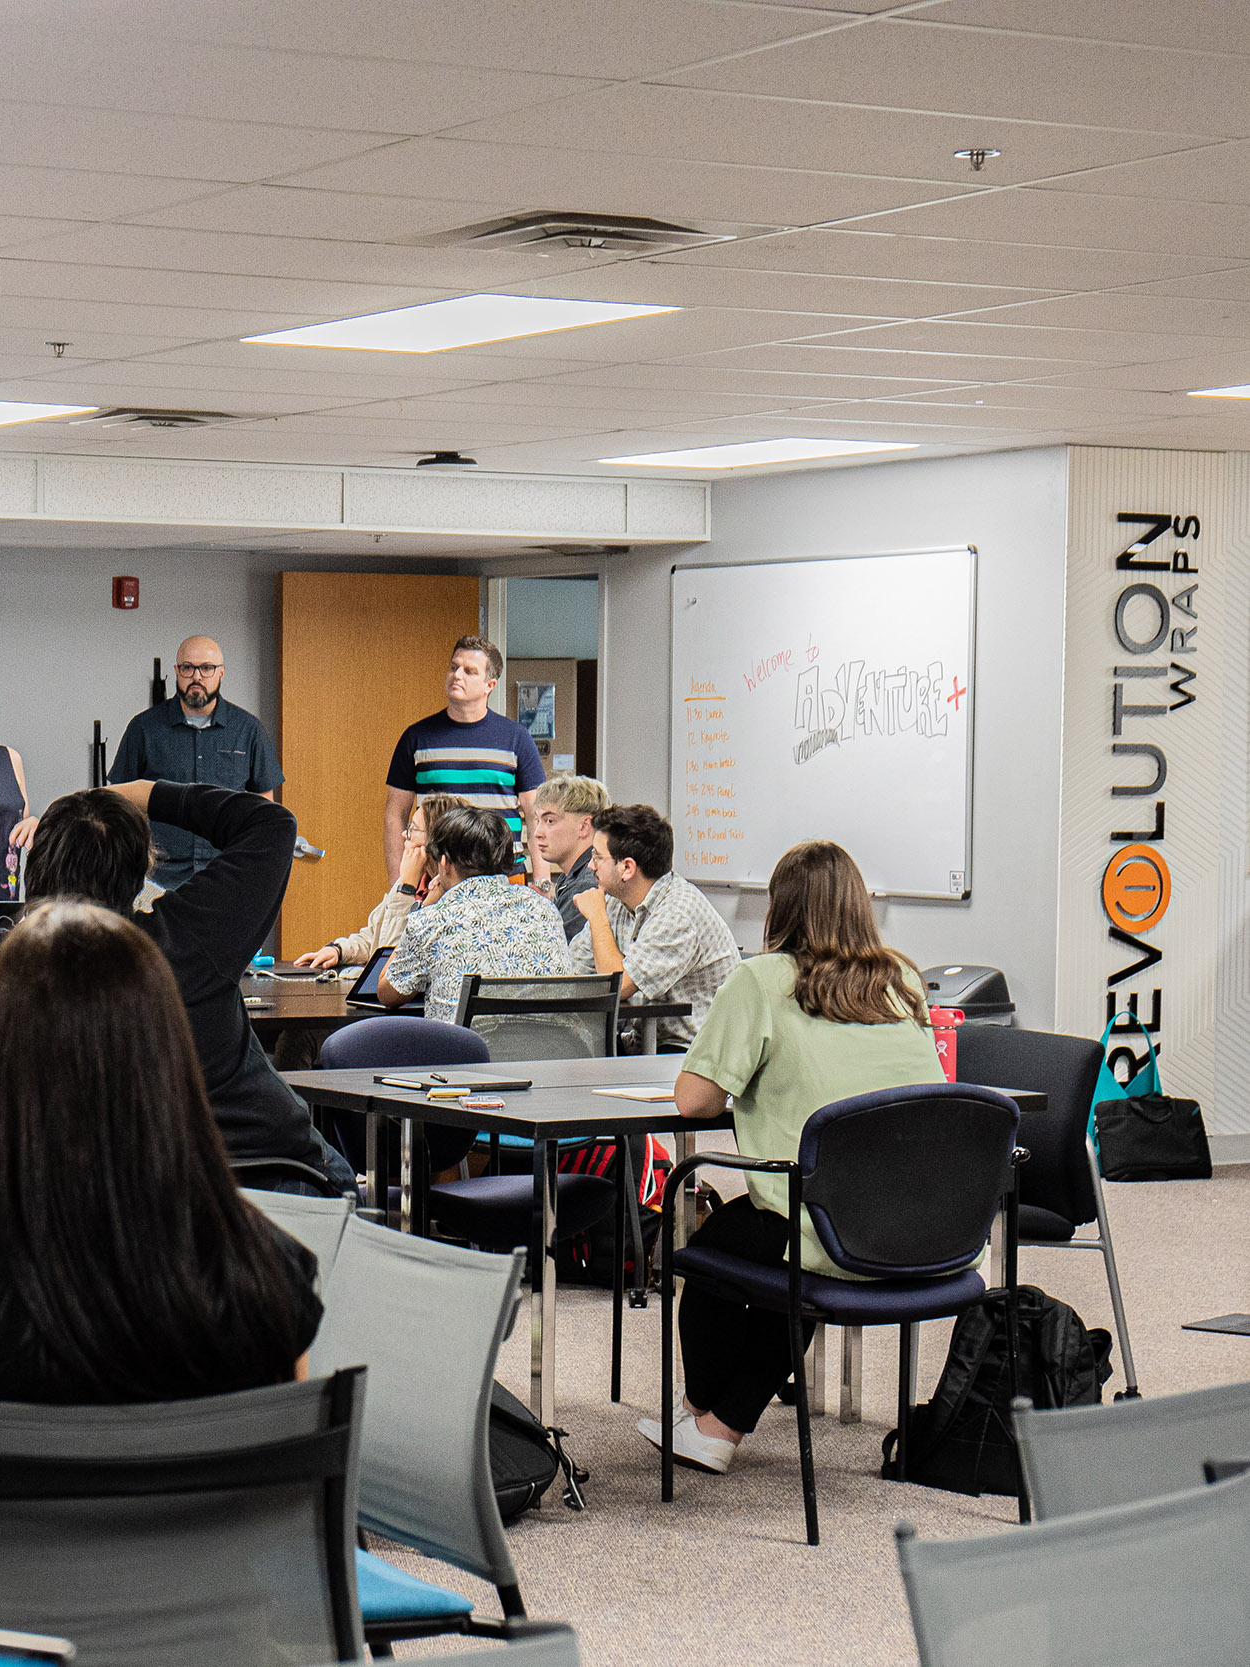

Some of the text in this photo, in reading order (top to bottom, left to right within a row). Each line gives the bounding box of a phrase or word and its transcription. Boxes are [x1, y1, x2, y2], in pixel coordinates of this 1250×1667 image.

[1170, 514, 1201, 711] WRAPS
[743, 632, 820, 692] Welcome to
[690, 675, 717, 696] Agenda
[705, 708, 723, 721] Lunch
[687, 731, 696, 747] 12
